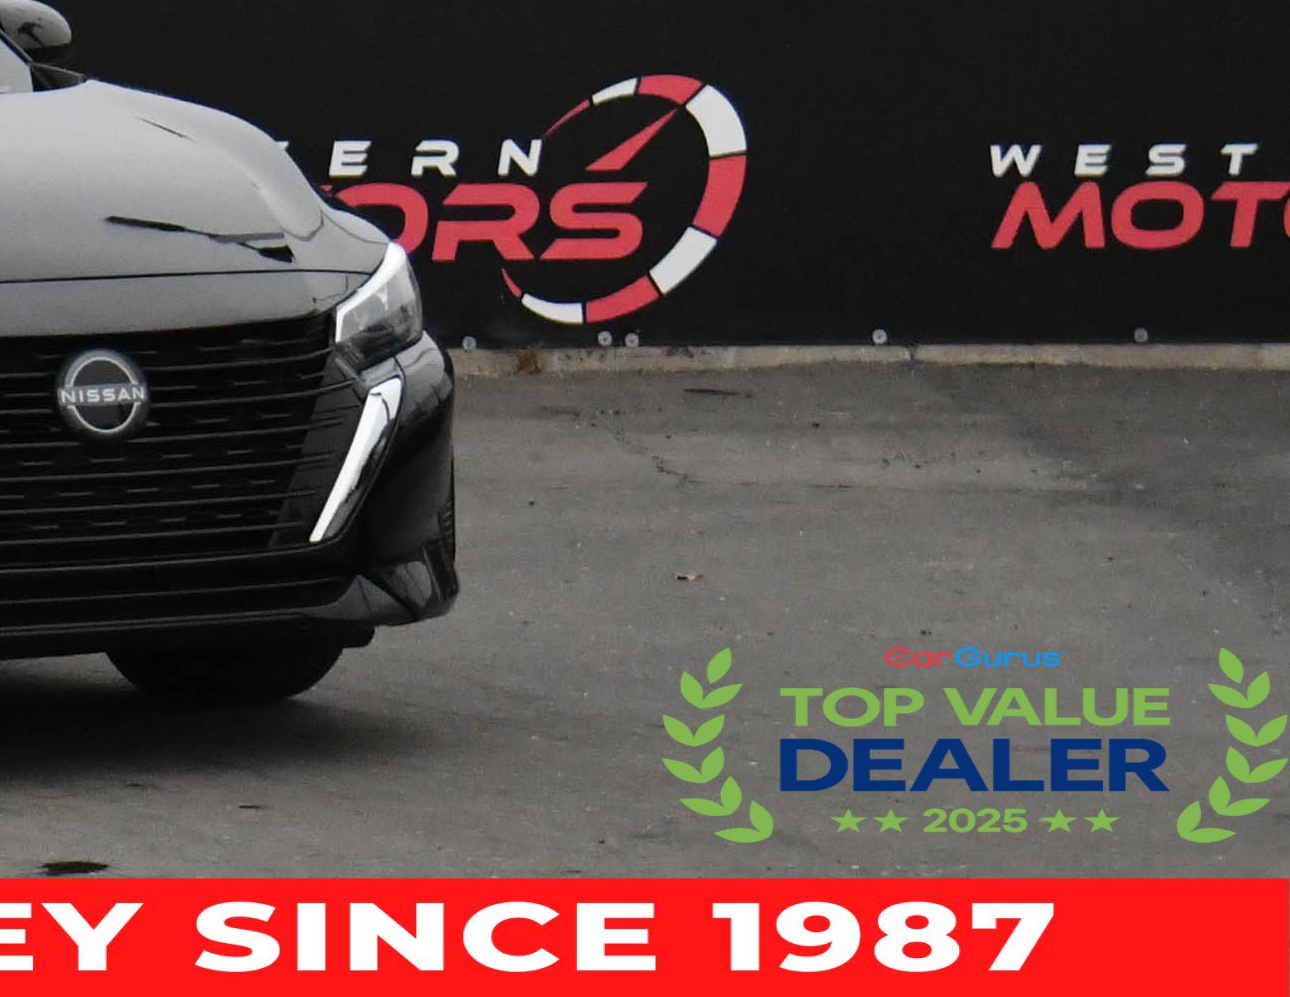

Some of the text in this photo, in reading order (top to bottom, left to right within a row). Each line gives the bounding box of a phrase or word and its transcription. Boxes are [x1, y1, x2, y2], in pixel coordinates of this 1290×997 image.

[279, 139, 542, 178] ERN
[989, 144, 1259, 177] WEST
[991, 180, 1290, 250] MOT
[60, 386, 146, 404] NISSAN
